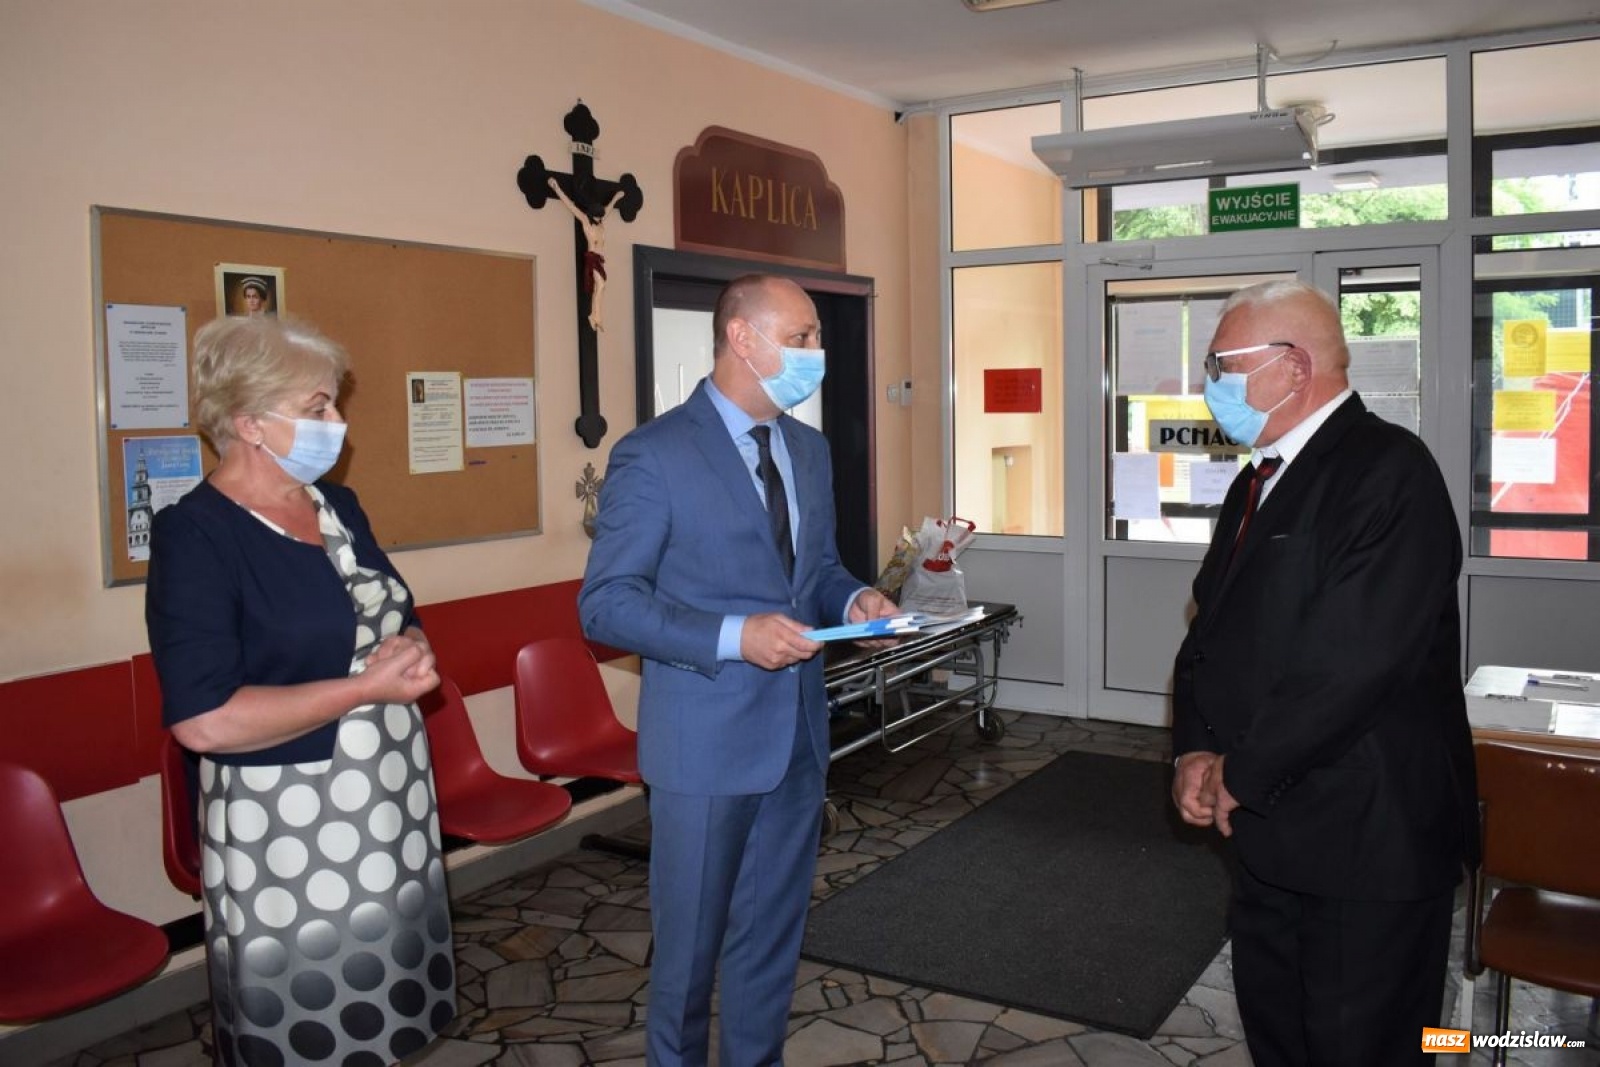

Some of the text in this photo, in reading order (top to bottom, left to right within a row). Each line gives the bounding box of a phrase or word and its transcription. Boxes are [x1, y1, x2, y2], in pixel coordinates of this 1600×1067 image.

[711, 167, 817, 231] KAPLICA
[1216, 191, 1292, 211] WYJŚCIE
[1211, 209, 1297, 225] EWAKUACYJNE
